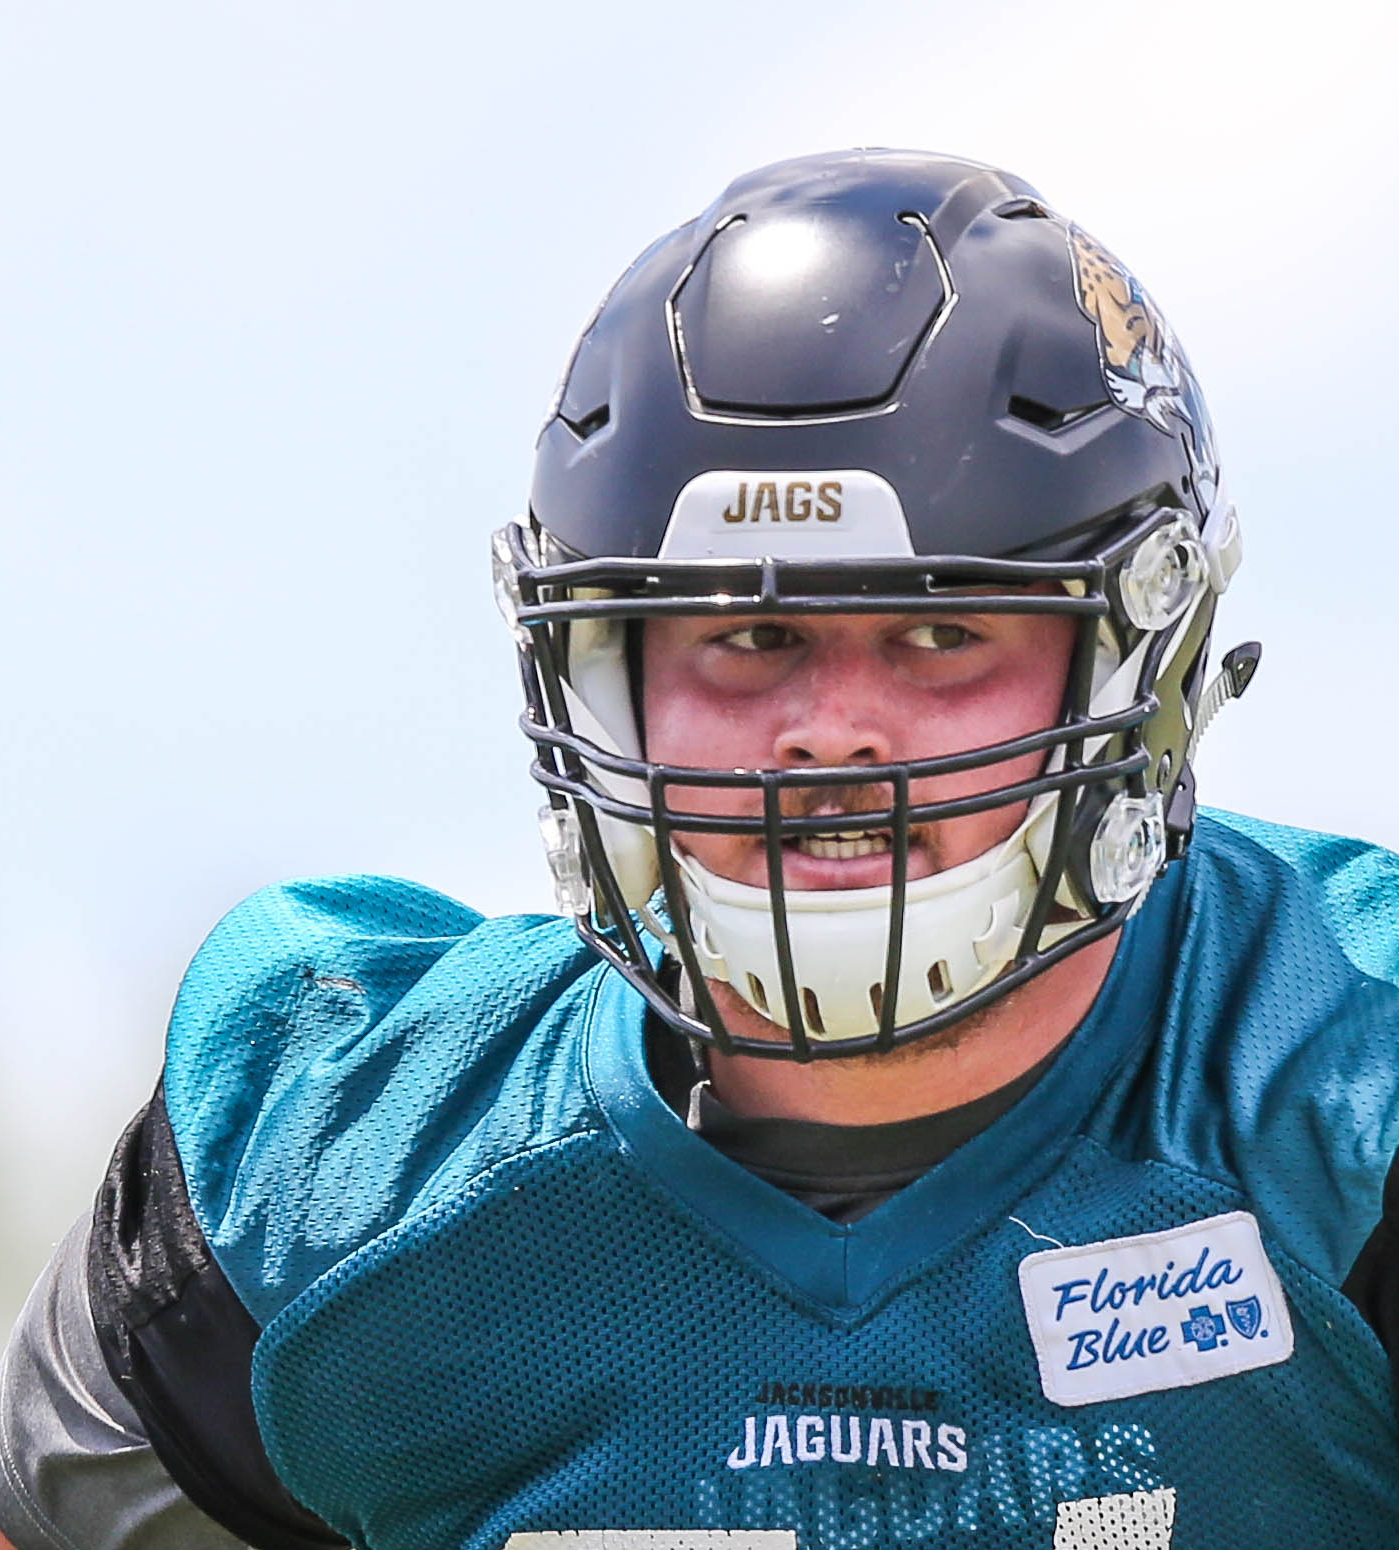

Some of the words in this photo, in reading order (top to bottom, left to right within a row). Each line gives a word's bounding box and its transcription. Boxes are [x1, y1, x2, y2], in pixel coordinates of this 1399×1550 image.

[721, 481, 844, 524] JAGS
[1051, 1246, 1244, 1322] Florida
[1066, 1317, 1171, 1371] Blue
[726, 1414, 968, 1473] JAGUARS
